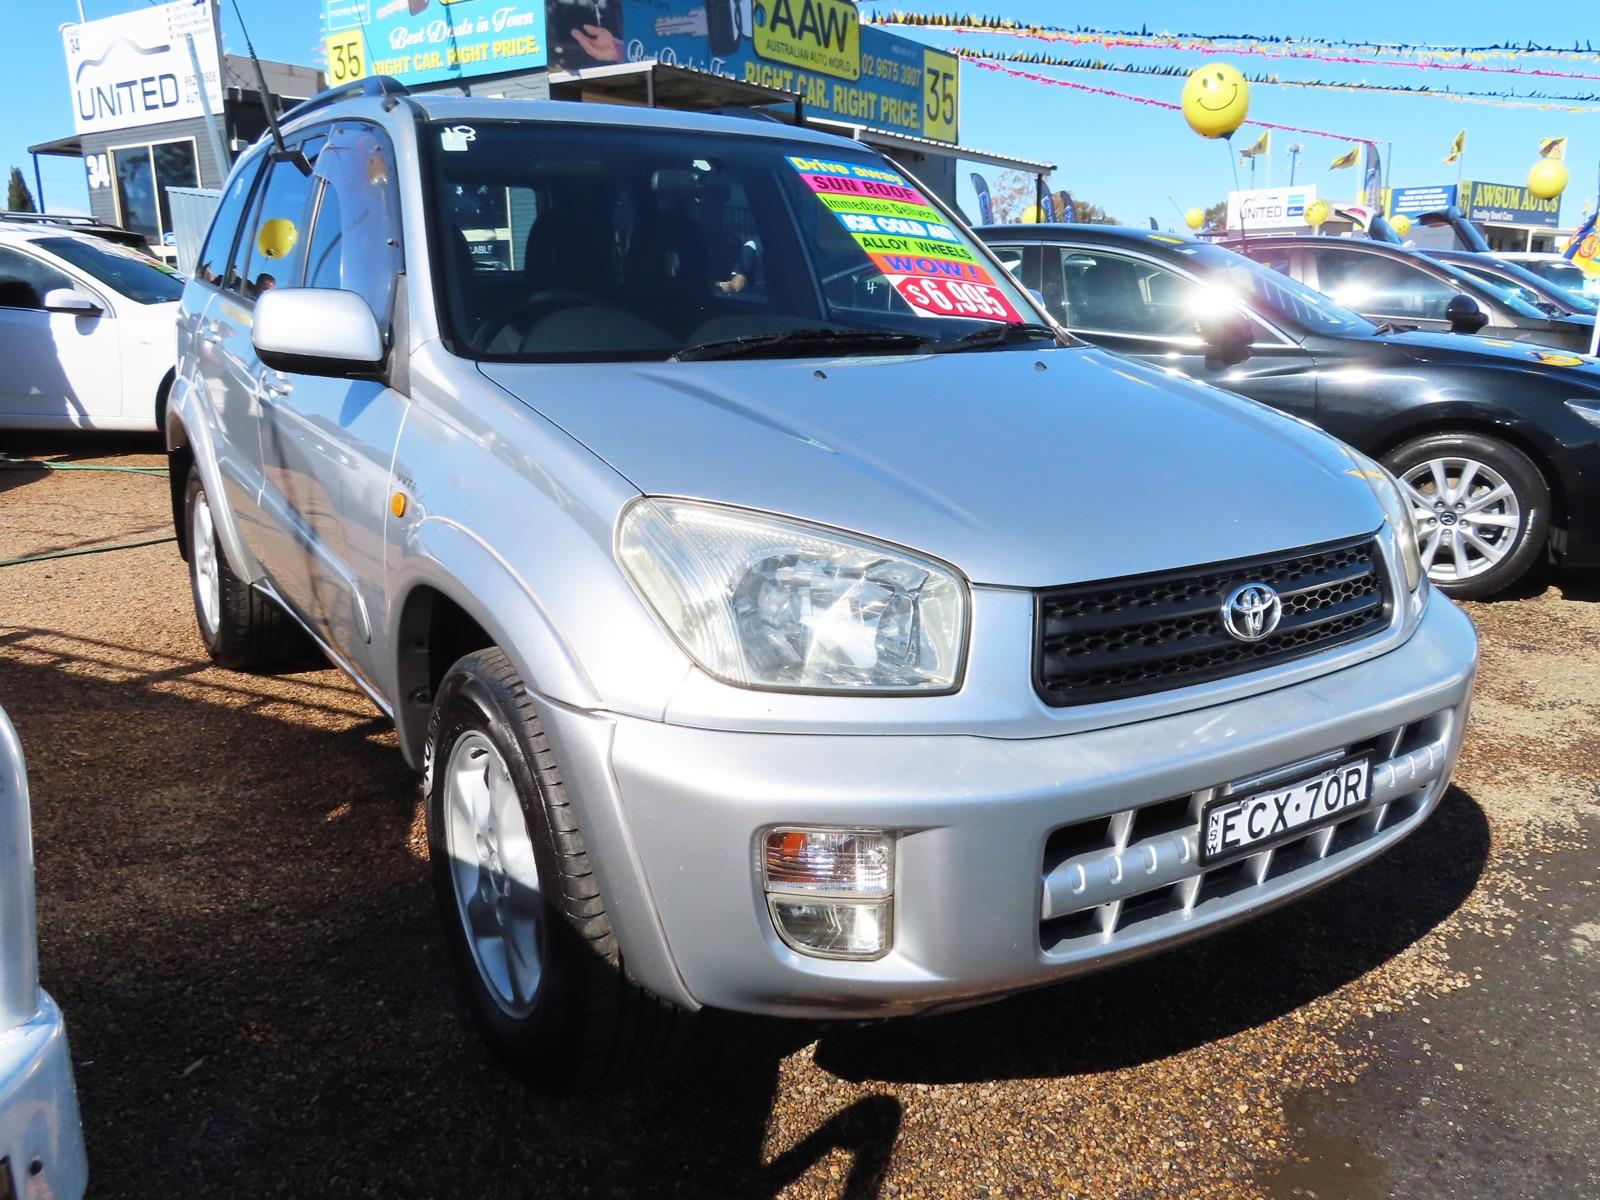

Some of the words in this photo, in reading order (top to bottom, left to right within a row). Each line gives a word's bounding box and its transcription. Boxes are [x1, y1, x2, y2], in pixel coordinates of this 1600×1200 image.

[389, 28, 425, 49] Best
[427, 20, 473, 44] Deals
[477, 16, 489, 33] in
[493, 7, 534, 32] Town
[770, 0, 849, 53] AAW
[332, 41, 362, 80] 35
[373, 57, 411, 77] RIGHT
[414, 50, 443, 71] CAR.
[447, 43, 491, 66] RIGHT
[493, 35, 542, 59] PRICE.
[766, 38, 810, 62] AUSTRALIAN
[809, 50, 828, 67] AUTO
[828, 55, 850, 73] WORLD
[861, 54, 874, 76] 02
[876, 59, 900, 82] 9675
[901, 64, 922, 87] 3907
[745, 61, 794, 91] RIGHT
[797, 74, 830, 108] CAR.
[833, 84, 878, 120] RIGHT
[880, 96, 921, 129] PRICE.
[927, 67, 955, 125] 35
[86, 153, 111, 188] 34
[790, 156, 850, 174] Drive
[851, 166, 905, 186] away
[812, 175, 860, 193] SUN
[861, 181, 915, 201] ROOF
[822, 197, 892, 214] Immediate
[891, 203, 941, 223] Delivery
[1473, 183, 1521, 210] AWSUM
[862, 236, 909, 250] ALLOY
[914, 241, 973, 260] WHEELS
[882, 255, 962, 277] WOW
[906, 278, 1008, 318] $6,995
[1206, 814, 1220, 856] NSW
